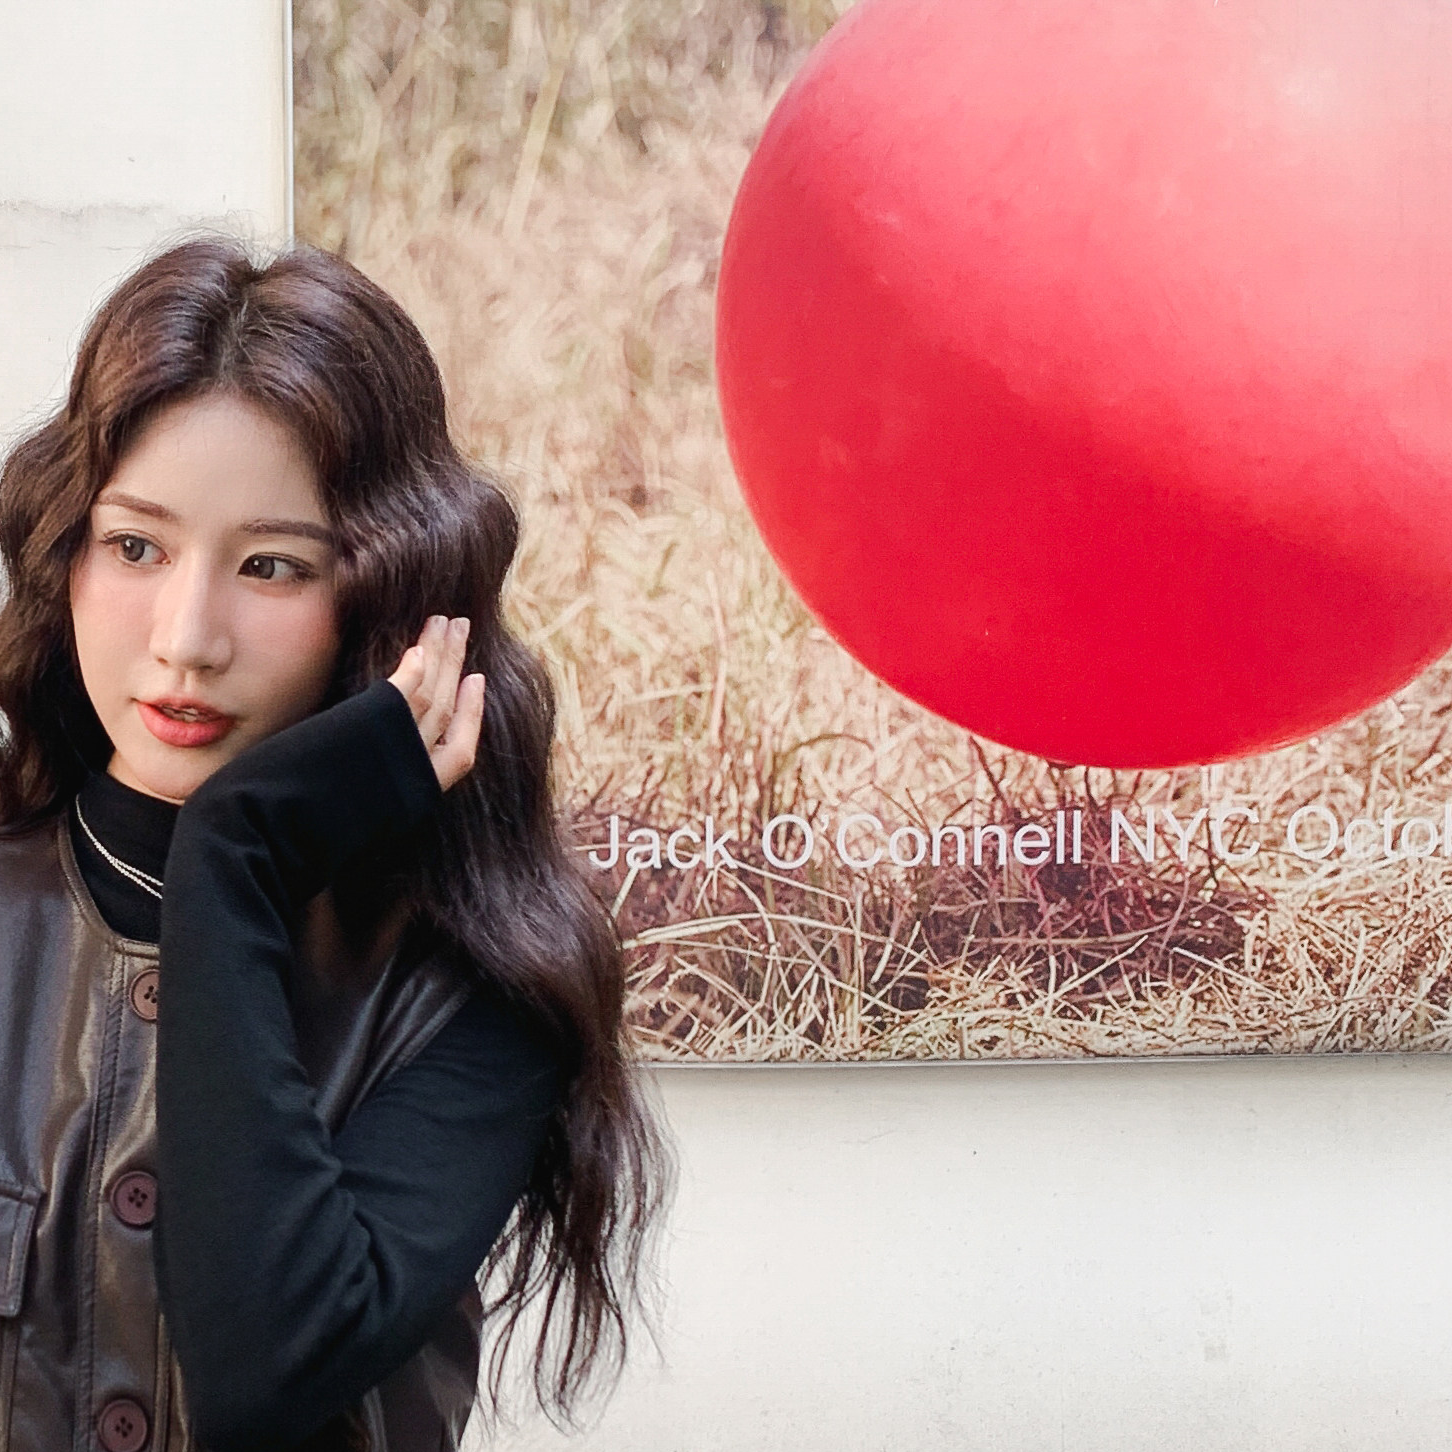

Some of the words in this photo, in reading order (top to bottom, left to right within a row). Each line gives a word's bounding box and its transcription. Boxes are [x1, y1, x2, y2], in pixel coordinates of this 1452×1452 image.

[588, 814, 738, 870] Jack
[762, 809, 1082, 870] O'Connell
[1110, 806, 1260, 864] NYC
[1286, 803, 1452, 860] Octo
